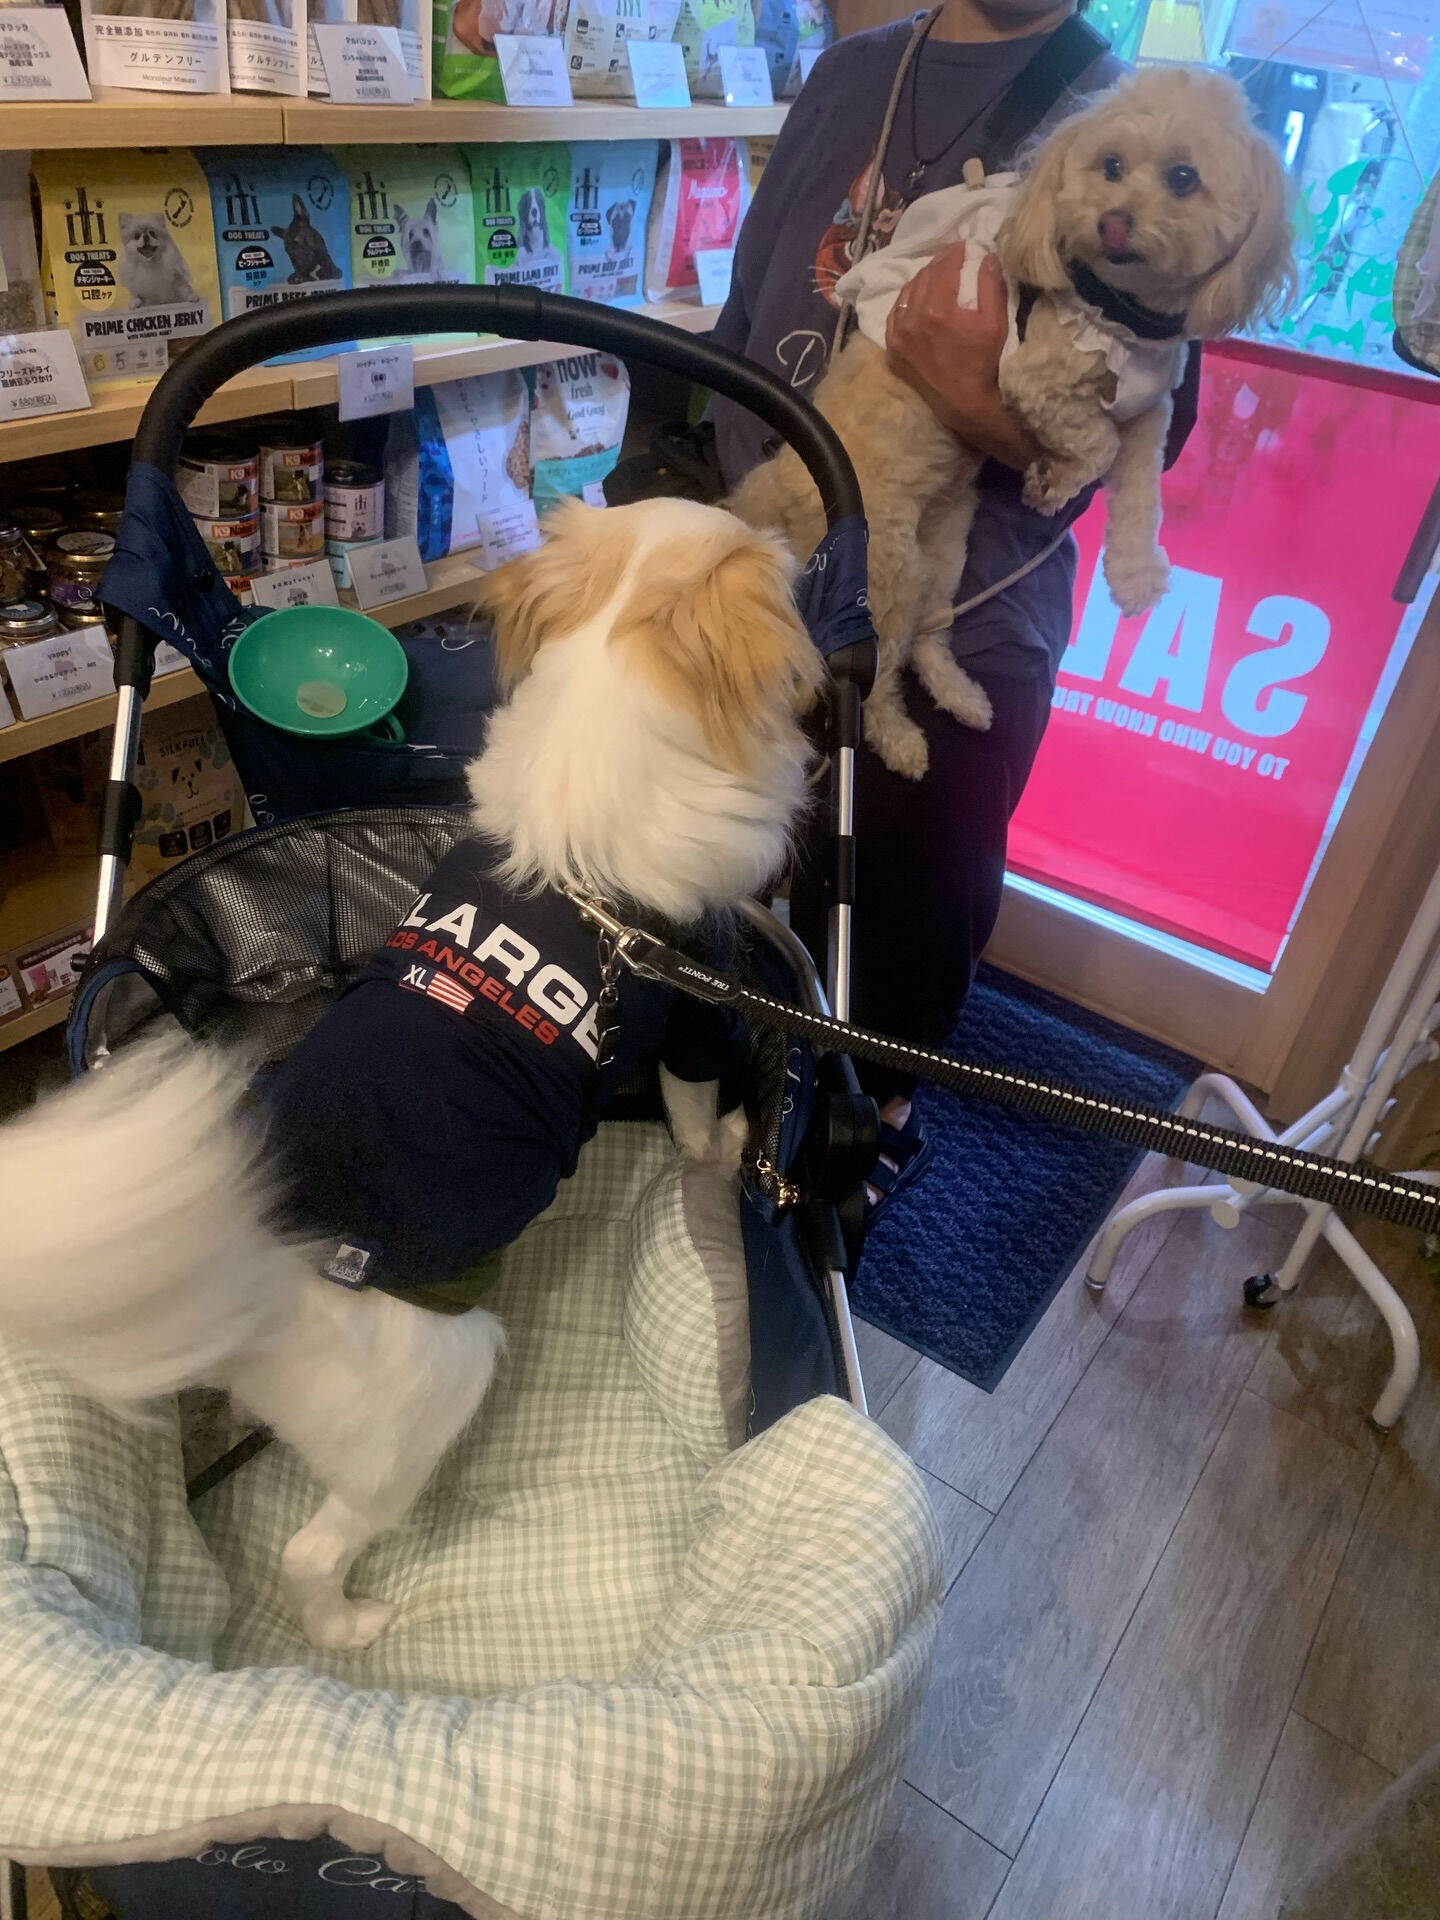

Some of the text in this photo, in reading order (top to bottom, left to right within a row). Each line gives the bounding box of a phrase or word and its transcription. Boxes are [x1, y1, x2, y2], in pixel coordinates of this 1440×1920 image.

[95, 25, 143, 36] 完全無添加
[130, 52, 201, 66] グルテンフリー
[247, 54, 295, 70] グルテンフリー
[244, 231, 265, 239] TREATS
[70, 251, 110, 261] DOG TREATS
[578, 257, 634, 275] PRIME BEEF JERKY
[76, 275, 113, 284] チキンジャーキー
[495, 265, 559, 285] PRIME LAMB JERKY
[82, 289, 113, 300] 口腔ケア
[246, 293, 280, 308] PRIME
[85, 310, 204, 337] PRIME CHICKEN JERKY
[0, 365, 50, 379] フリーズドライ
[558, 355, 597, 383] now
[571, 384, 593, 401] fresh
[48, 647, 72, 660] yappy!
[160, 736, 206, 757] SILKFULL
[403, 964, 428, 990] XL
[417, 938, 560, 1046] ANGELES
